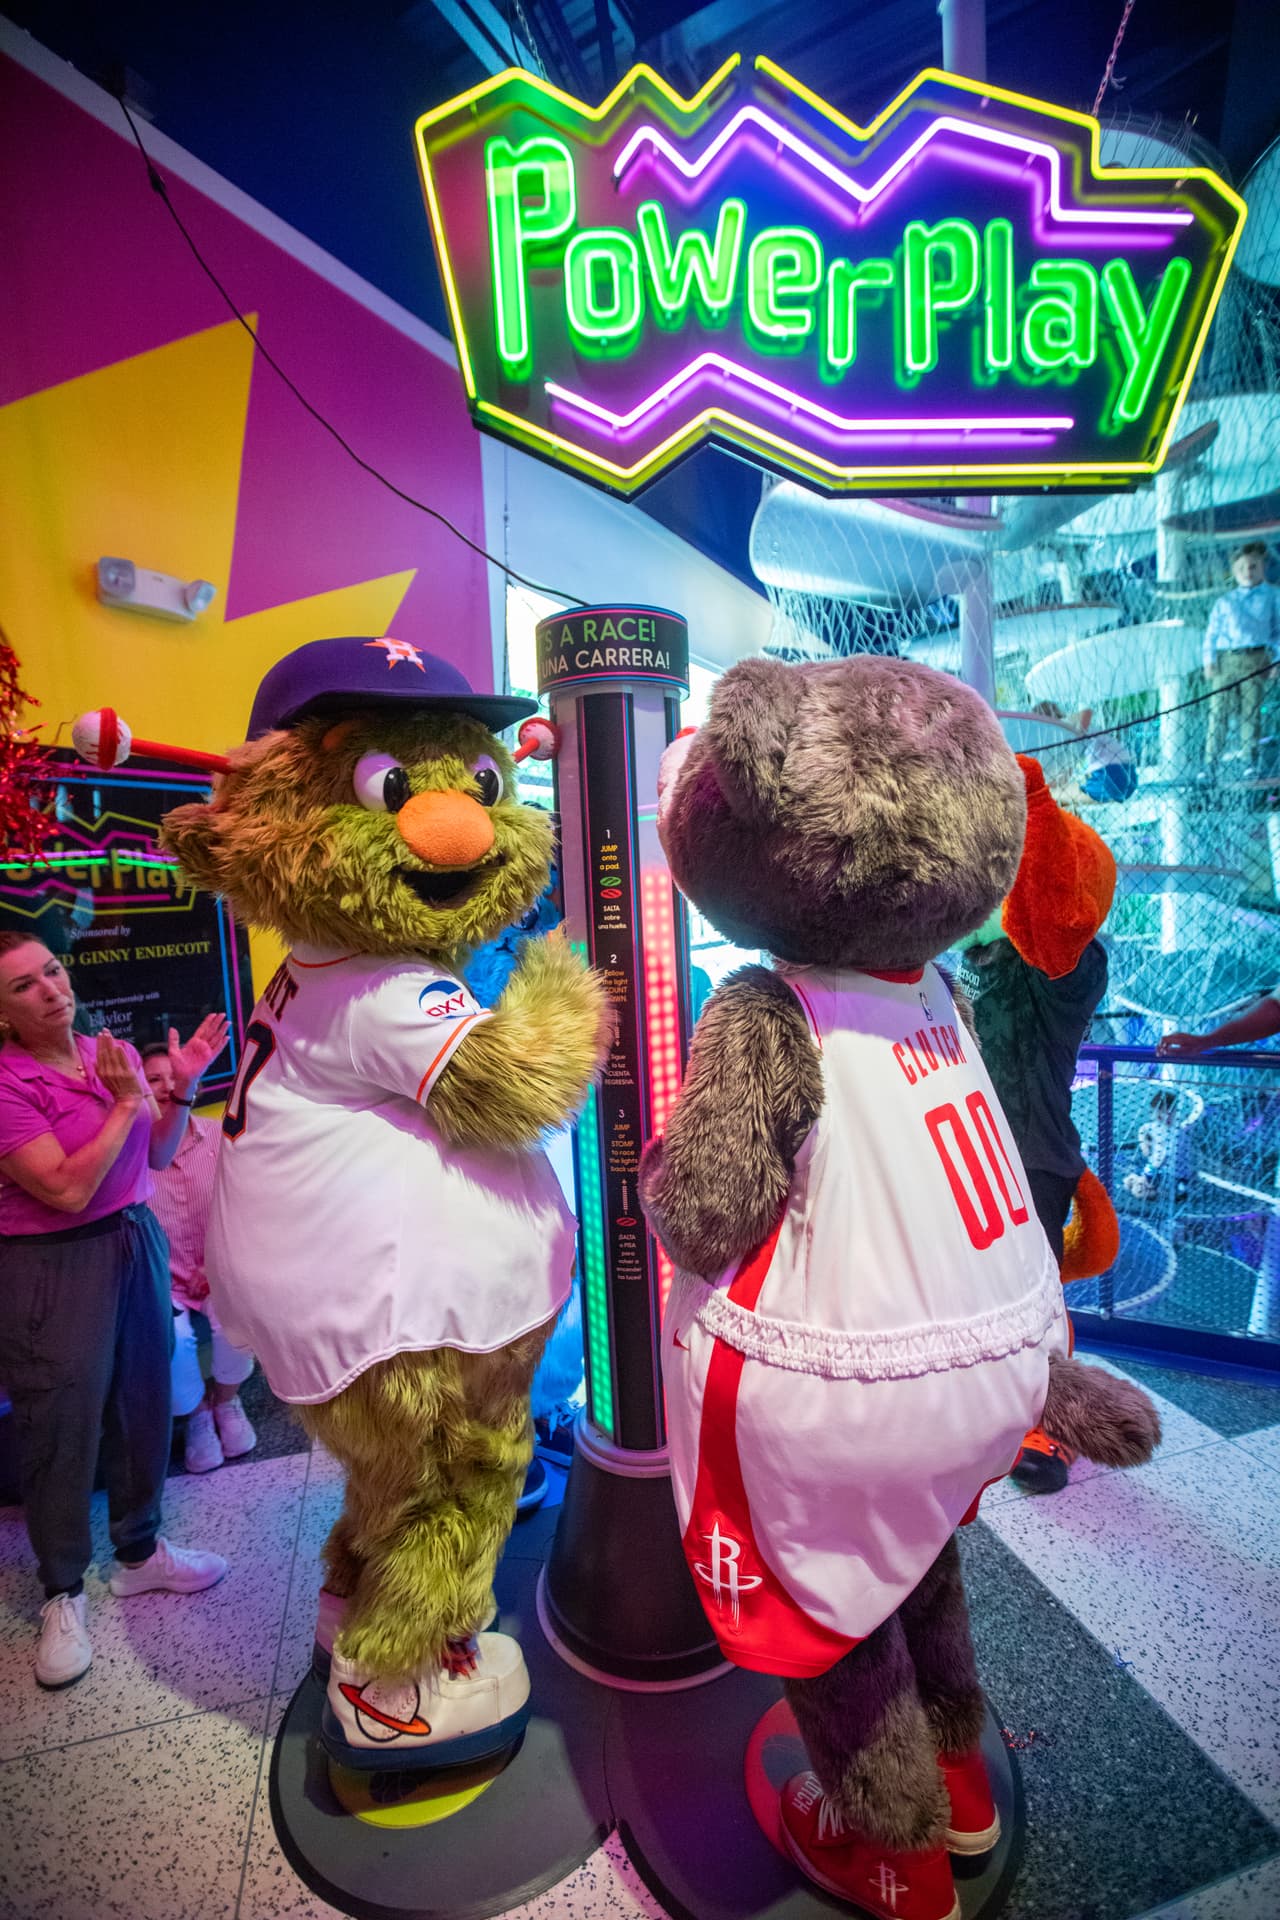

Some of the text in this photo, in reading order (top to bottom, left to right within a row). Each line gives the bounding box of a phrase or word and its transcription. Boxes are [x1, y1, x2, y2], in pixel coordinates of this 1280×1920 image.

[485, 135, 1191, 423] PowerPlay
[560, 623, 574, 647] A
[583, 617, 656, 643] RACE!
[575, 648, 670, 670] CARRERA!
[601, 844, 618, 852] JUMP
[80, 949, 131, 966] GINNY
[610, 954, 617, 964] 2
[426, 993, 465, 1017] OXY
[892, 1024, 967, 1086] CLUTCH
[619, 1104, 625, 1118] 3
[611, 1140, 634, 1148] STOMP
